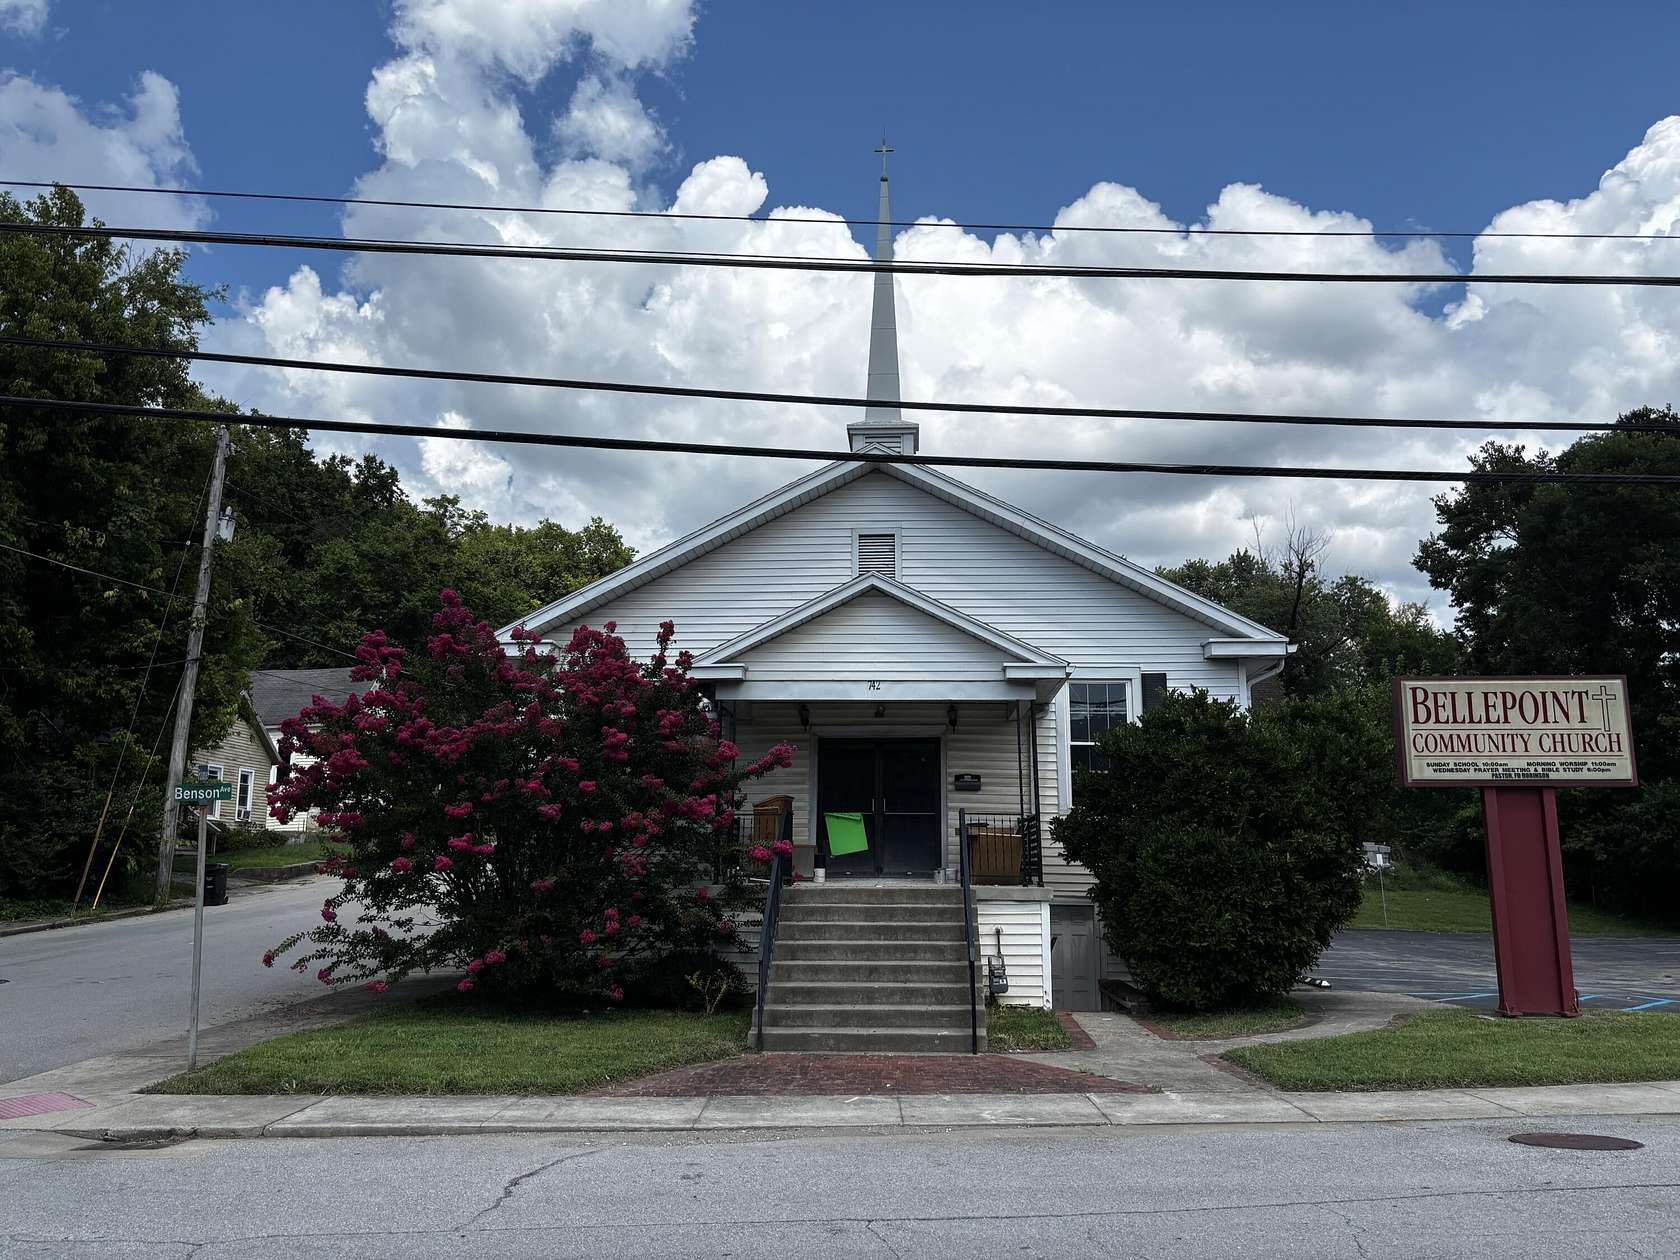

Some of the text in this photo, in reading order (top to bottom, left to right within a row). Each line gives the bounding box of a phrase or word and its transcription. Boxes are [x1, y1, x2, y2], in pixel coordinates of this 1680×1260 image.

[1409, 686, 1589, 725] BELLEPOINT
[1412, 732, 1623, 754] COMMUNITY CHURCH
[175, 787, 220, 800] Benson
